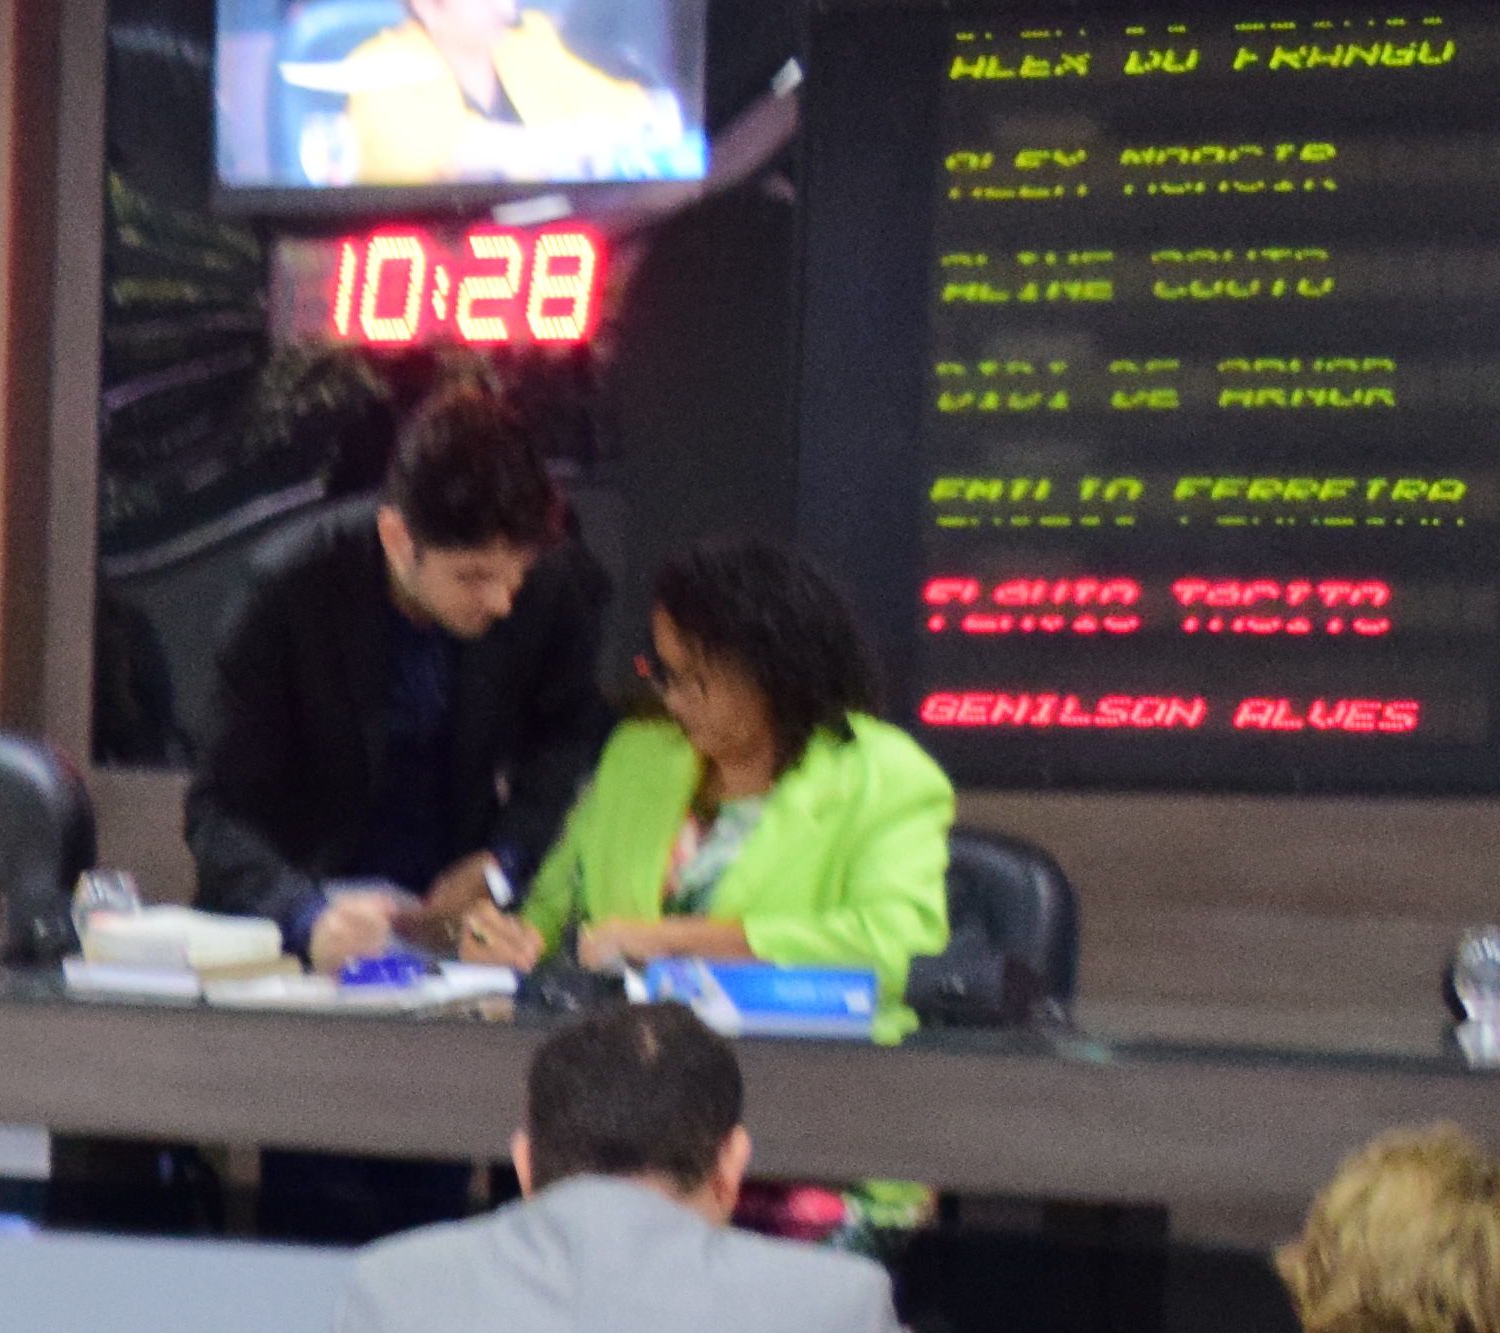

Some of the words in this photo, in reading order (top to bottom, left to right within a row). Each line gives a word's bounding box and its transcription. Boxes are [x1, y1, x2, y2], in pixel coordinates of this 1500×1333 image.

[950, 32, 1090, 79] ALEX
[946, 150, 1086, 198] ALEX
[332, 231, 597, 343] 10:28
[942, 252, 1113, 302] ALINE
[1110, 360, 1178, 408] DE
[930, 477, 1143, 526] EMILIO
[1174, 477, 1467, 525] FERREIRA
[924, 577, 1140, 632] FLAVIO
[1173, 577, 1390, 633] TACITO
[920, 693, 1206, 729] GENILSON
[1233, 699, 1419, 731] ALVES
